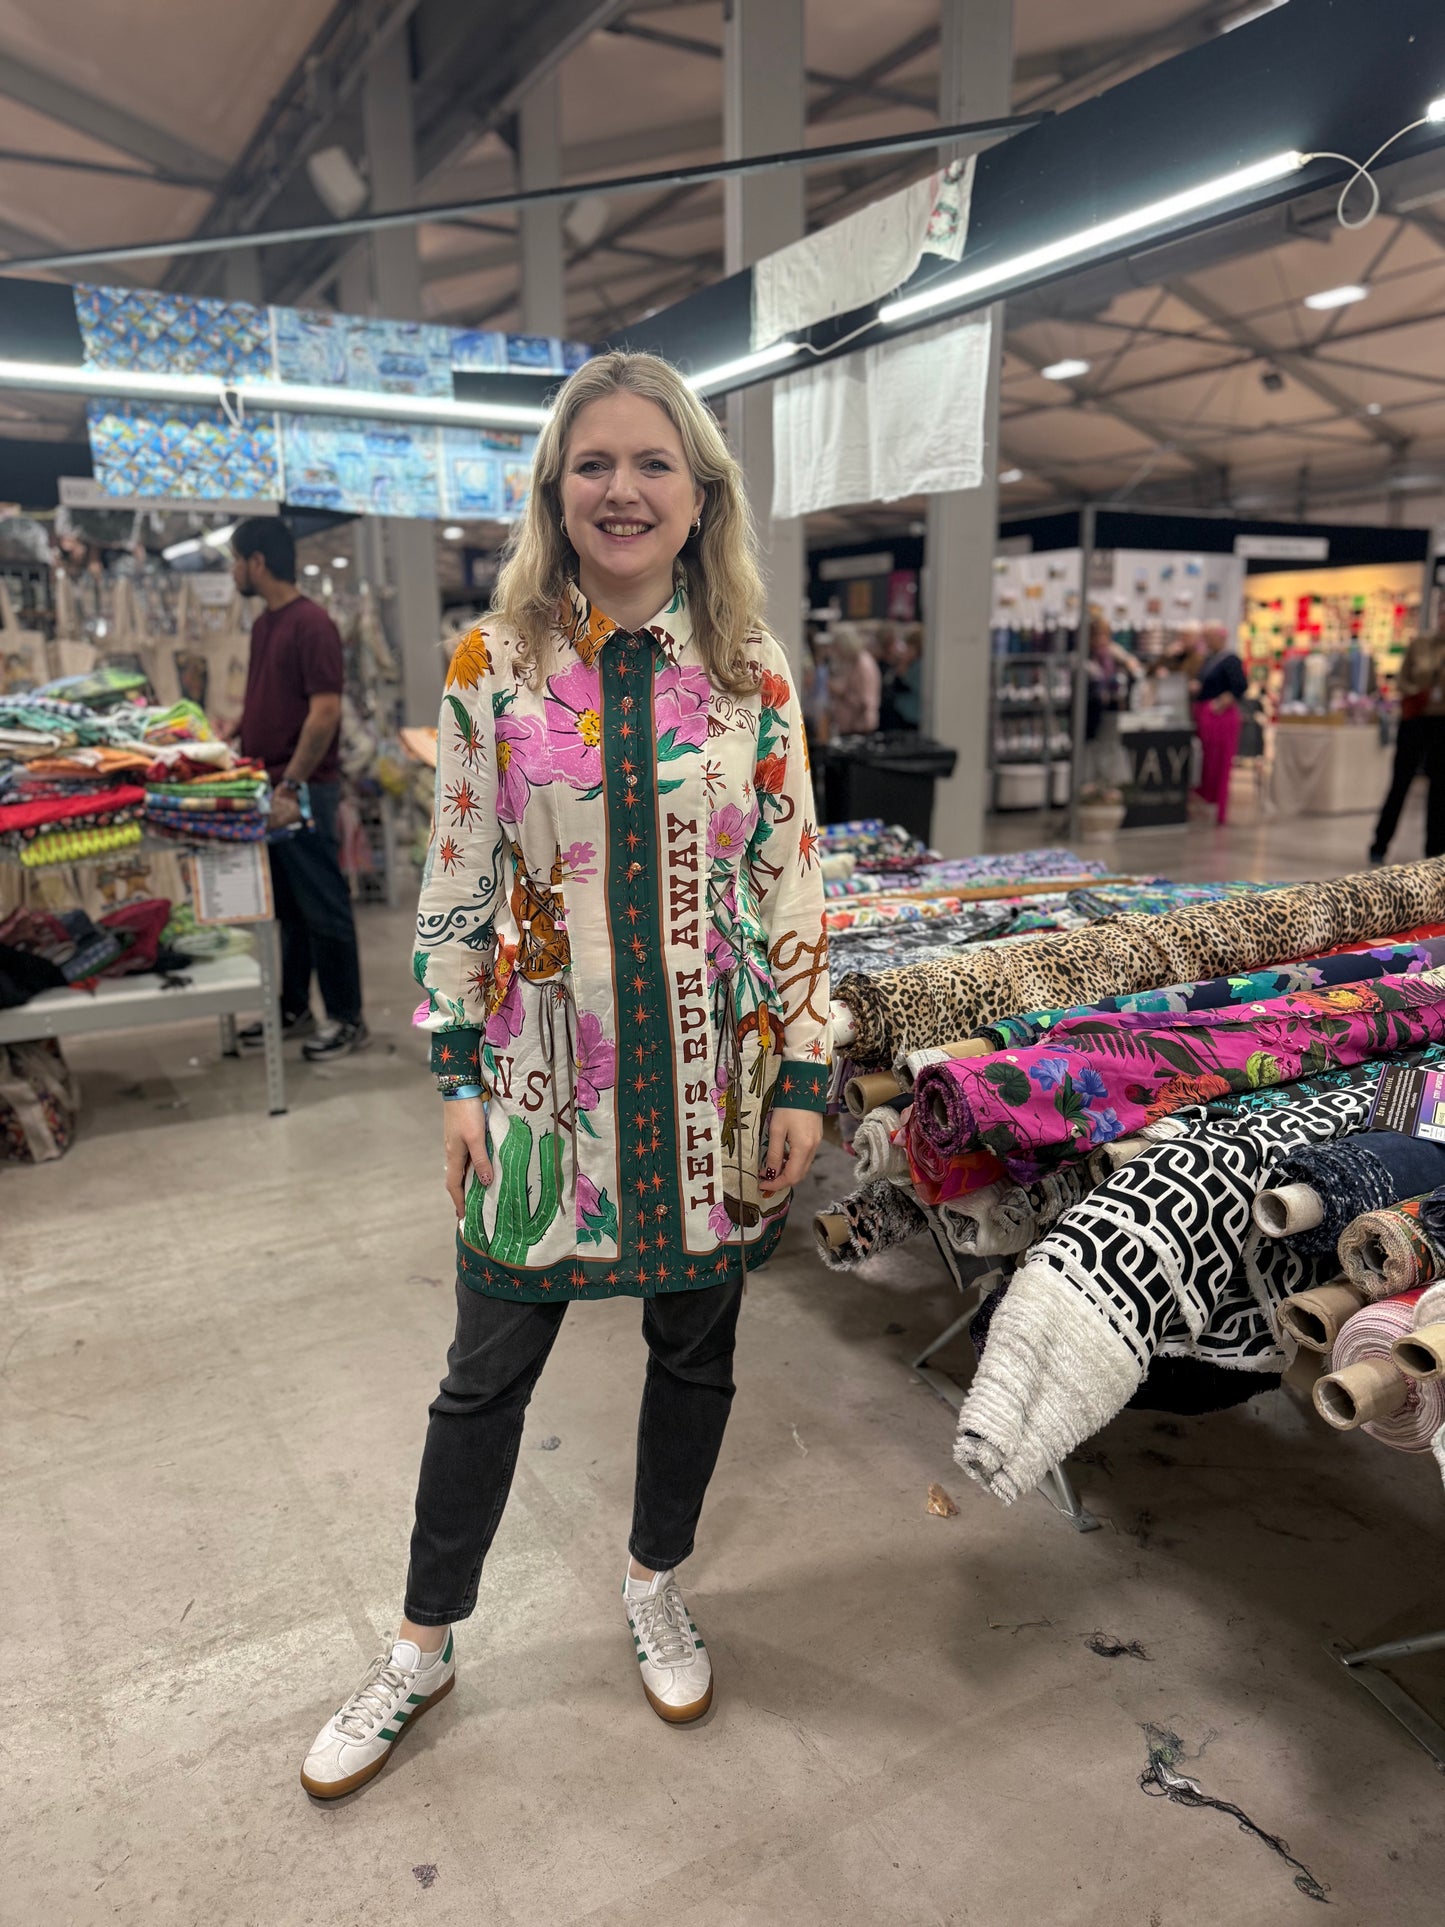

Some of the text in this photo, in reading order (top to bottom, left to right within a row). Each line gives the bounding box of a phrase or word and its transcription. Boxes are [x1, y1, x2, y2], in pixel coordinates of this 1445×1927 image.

[667, 812, 716, 1210] LET'S RUN AWAY
